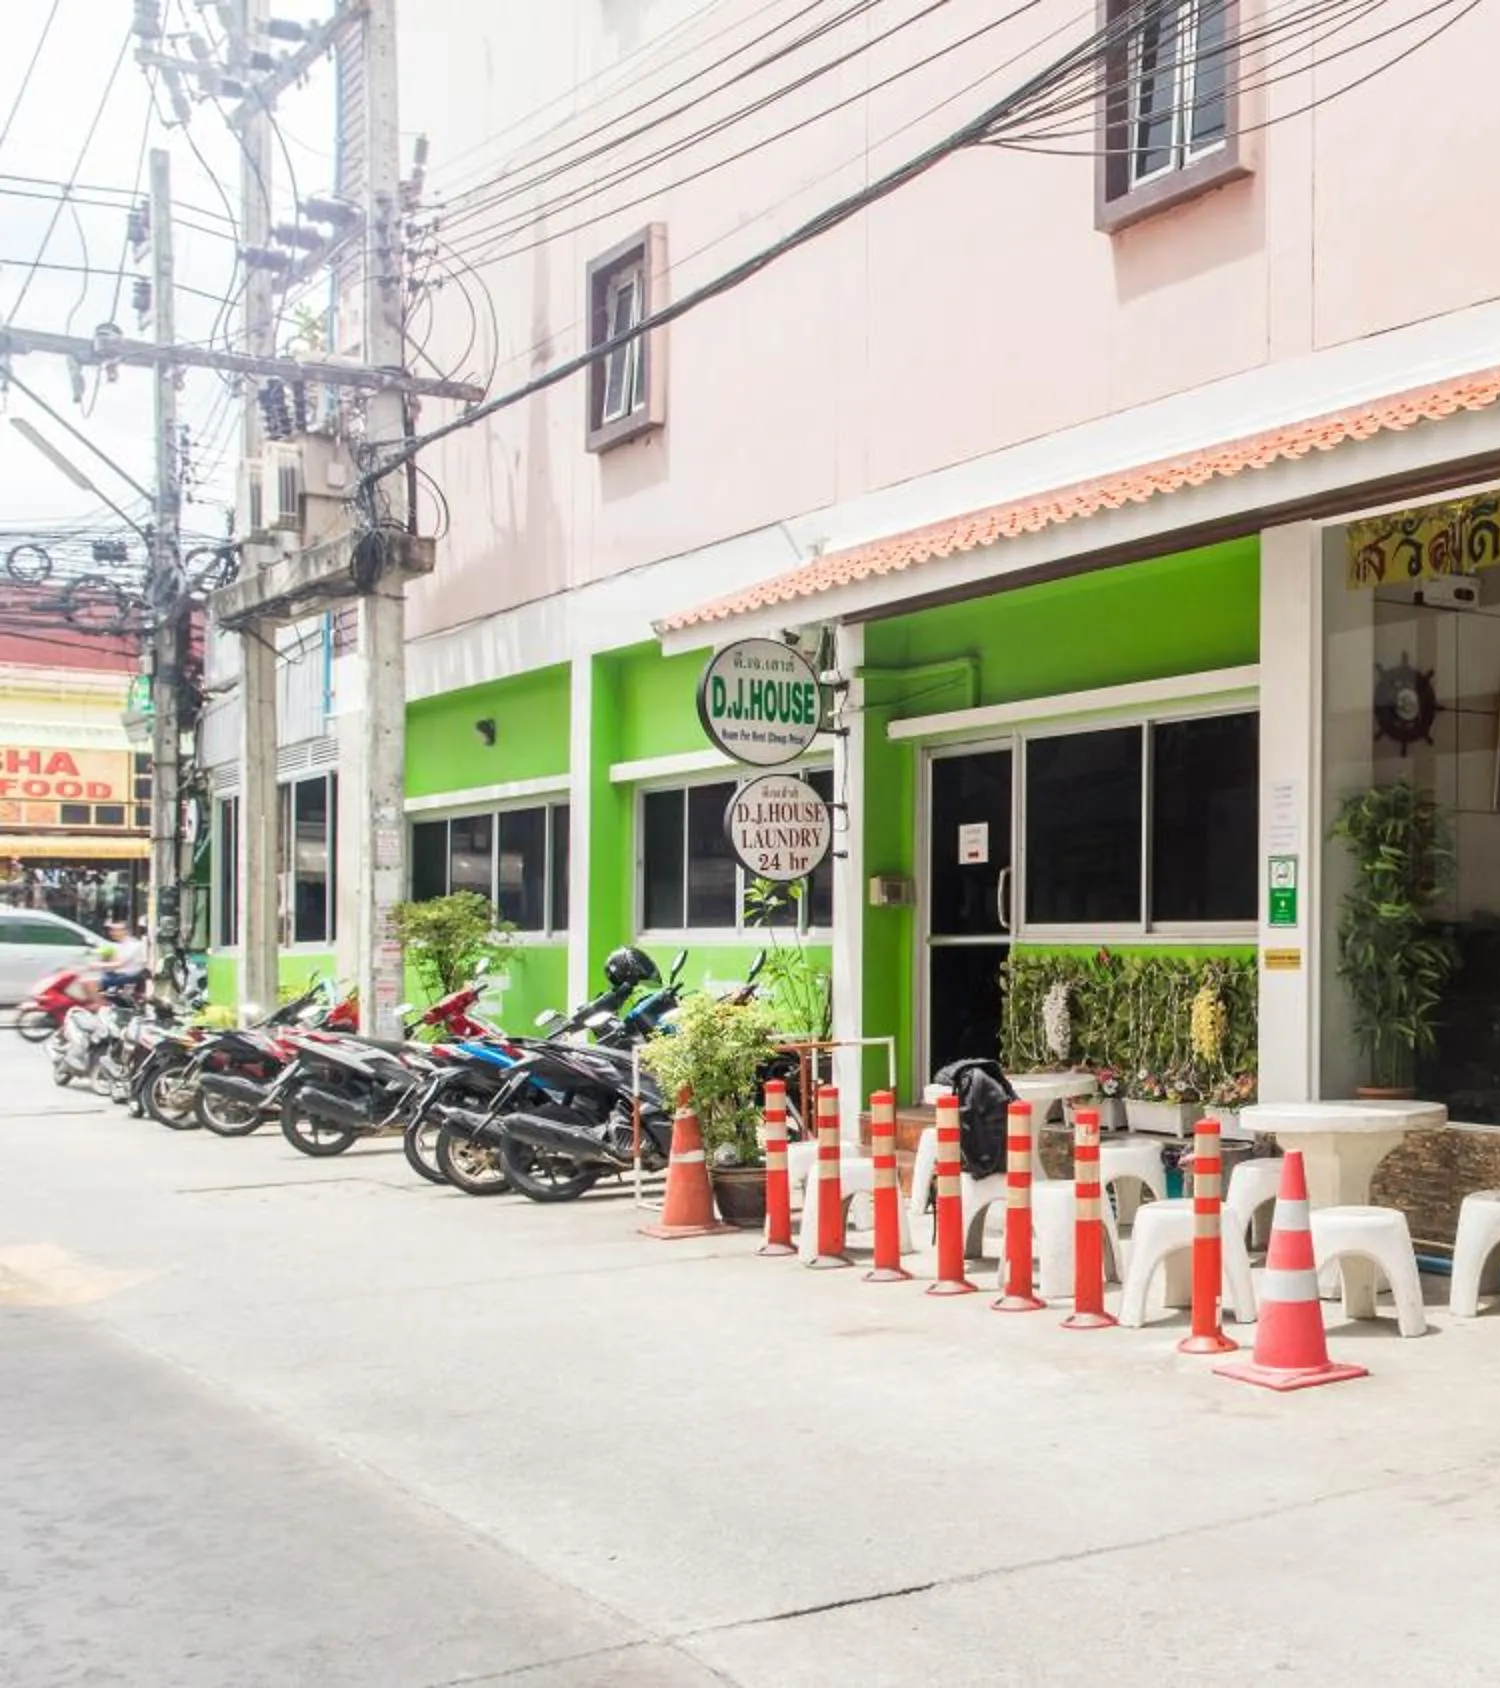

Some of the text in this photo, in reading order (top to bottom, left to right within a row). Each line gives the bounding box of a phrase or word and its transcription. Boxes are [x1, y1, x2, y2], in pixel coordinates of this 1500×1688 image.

[712, 675, 815, 725] D.J.HOUSE
[0, 749, 80, 777] HA
[0, 779, 113, 799] FOOD
[737, 803, 825, 824] D.J.HOUSE
[742, 828, 823, 849] LAUNDRY
[758, 852, 809, 871] 24 hr
